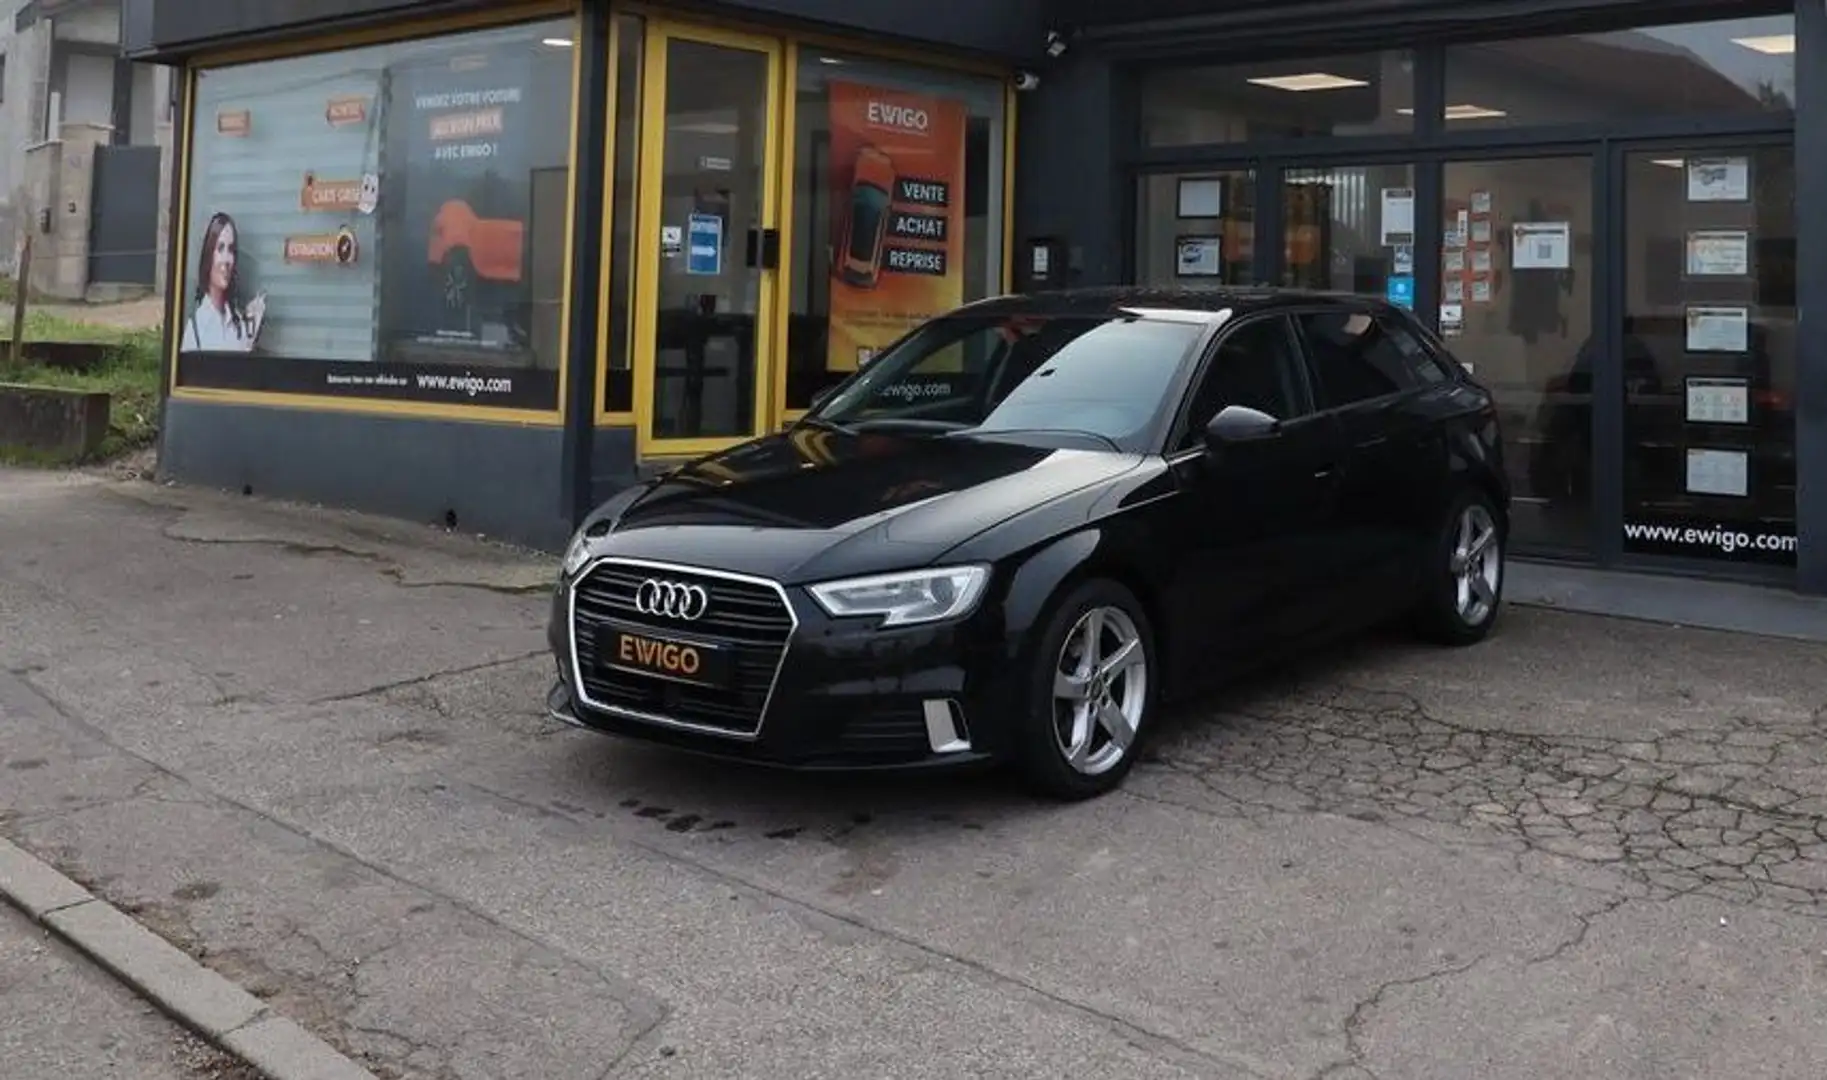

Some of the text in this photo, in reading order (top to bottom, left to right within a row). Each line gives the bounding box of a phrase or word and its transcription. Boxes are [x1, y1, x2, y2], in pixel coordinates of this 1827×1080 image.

[868, 101, 928, 129] EWIGO
[903, 181, 945, 202] VENTE
[896, 215, 943, 235] ACHAT
[890, 251, 942, 271] REPRISE
[416, 371, 512, 396] www.ewigo.com
[881, 378, 951, 402] ewigo.com
[1624, 524, 1798, 552] www.ewigo.com
[619, 633, 700, 674] EWIGO
